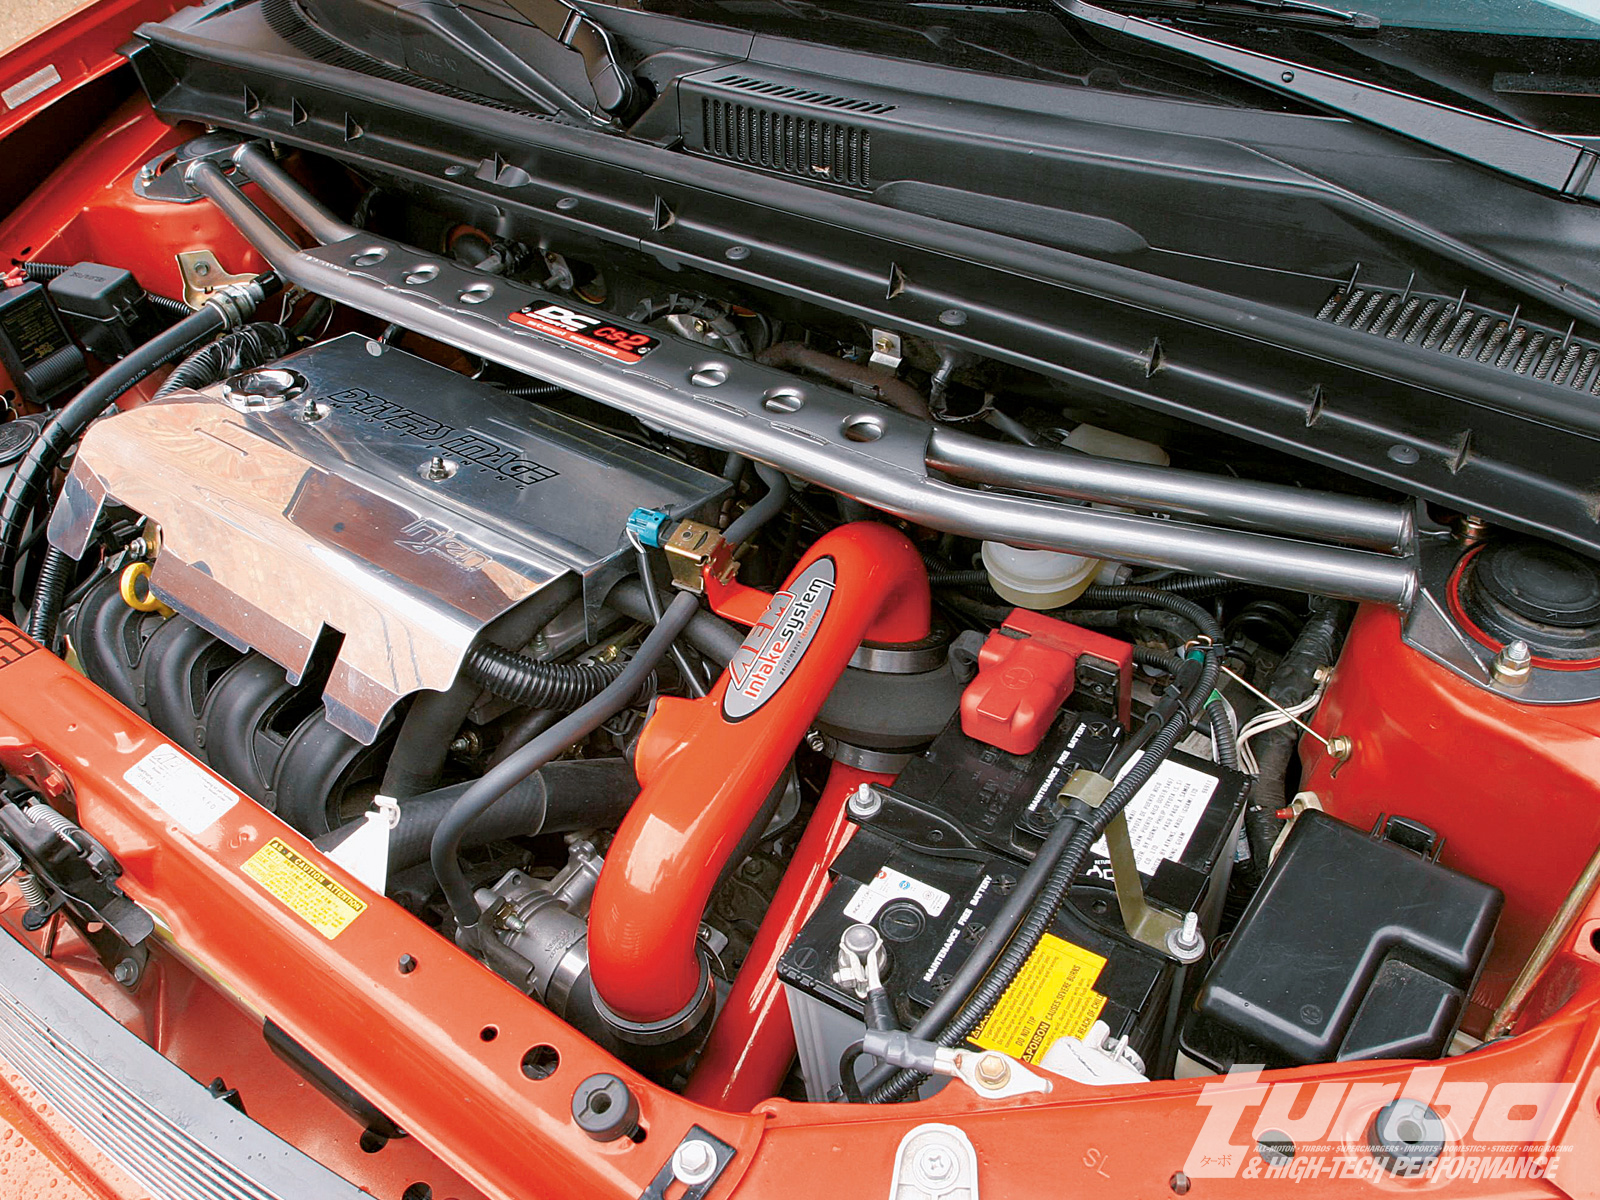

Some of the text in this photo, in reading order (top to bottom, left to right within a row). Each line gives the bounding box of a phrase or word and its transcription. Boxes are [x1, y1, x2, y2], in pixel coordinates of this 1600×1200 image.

[531, 305, 601, 330] DC
[729, 591, 797, 690] AEM
[1027, 722, 1088, 812] MAINTENANCE FREE BATTERY
[294, 858, 363, 911] CAUTION ATTENTION
[923, 928, 961, 983] MAINTENANCE
[957, 907, 974, 926] FREE
[969, 874, 993, 907] BATTERY
[1015, 1016, 1036, 1046] DO NOT TIP
[1026, 965, 1080, 1055] POISON CAUSES SEVERE BURNS
[1077, 1017, 1091, 1035] REACH
[1087, 1009, 1095, 1017] OF
